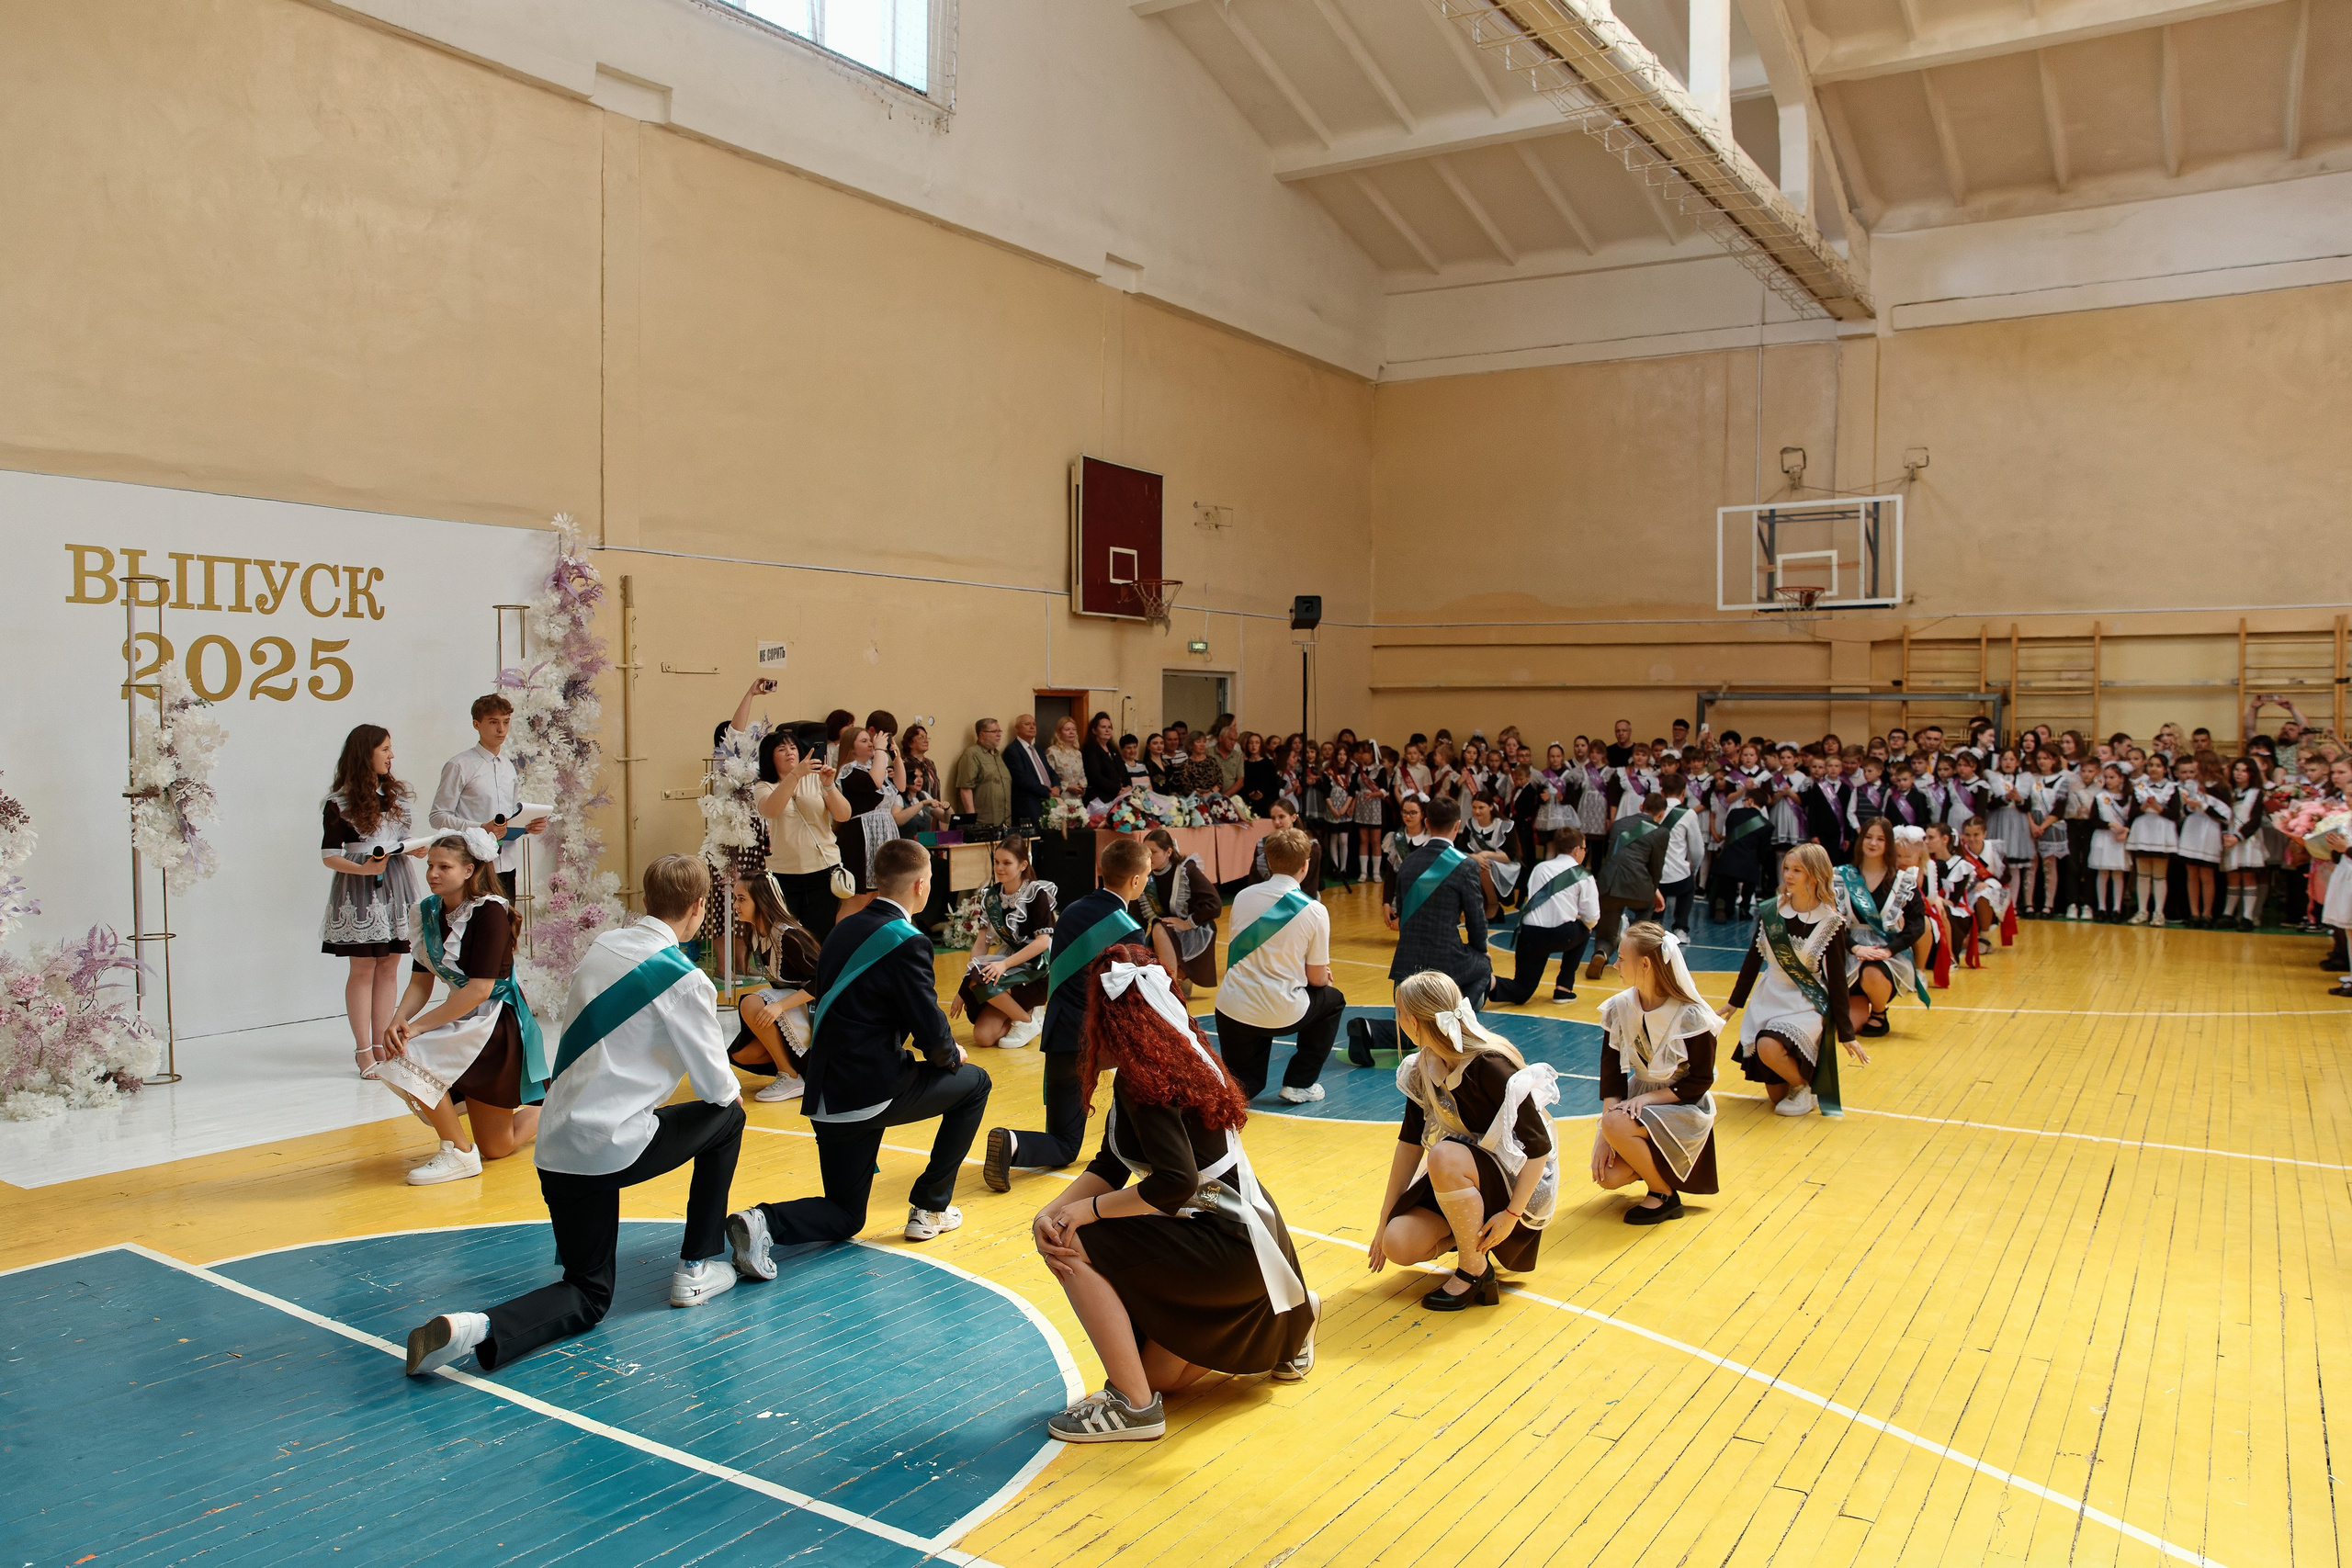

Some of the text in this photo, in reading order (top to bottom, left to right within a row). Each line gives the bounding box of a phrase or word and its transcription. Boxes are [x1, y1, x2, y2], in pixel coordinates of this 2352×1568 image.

[64, 543, 385, 621] ВЫПУСК
[120, 632, 354, 701] 2025
[759, 646, 786, 663] НЕ СОРИТЬ
